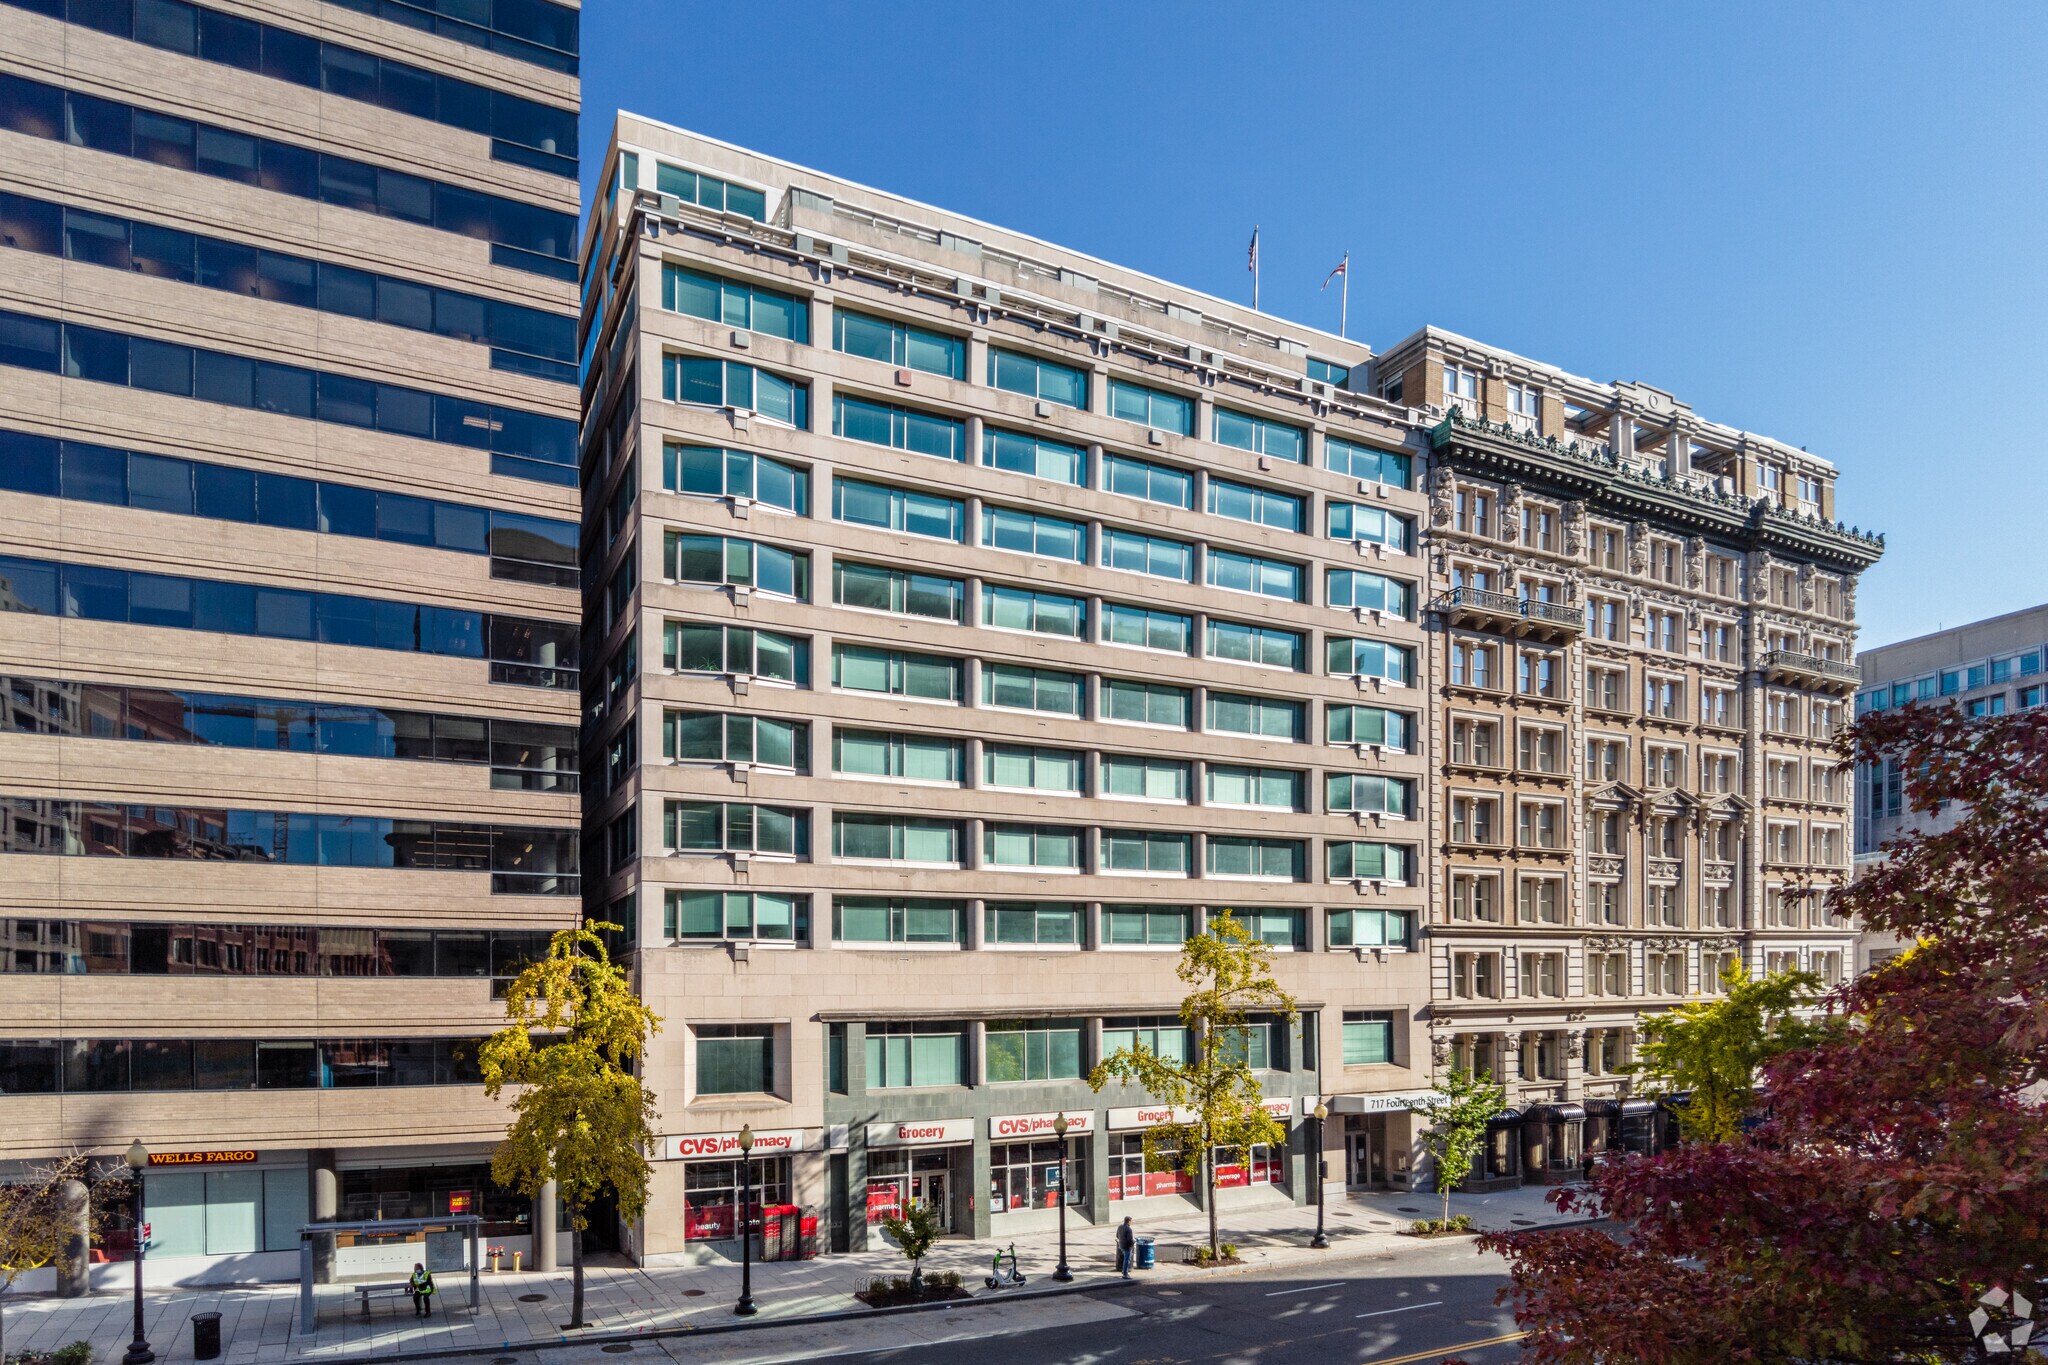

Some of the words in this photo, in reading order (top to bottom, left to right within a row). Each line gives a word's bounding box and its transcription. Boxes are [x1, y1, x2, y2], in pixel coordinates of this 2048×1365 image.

[1371, 1099, 1385, 1109] 717
[1427, 1096, 1448, 1106] Street
[1138, 1110, 1175, 1122] Grocery
[999, 1117, 1087, 1134] CVS/phaacy
[898, 1126, 945, 1139] Grocery
[679, 1136, 793, 1155] CVS/phmacy
[150, 1153, 202, 1163] WELLS
[206, 1151, 255, 1161] FARGO
[1217, 1173, 1241, 1181] beverage
[1155, 1181, 1182, 1190] pharmacy
[695, 1222, 721, 1231] beauty
[739, 1218, 761, 1228] poto
